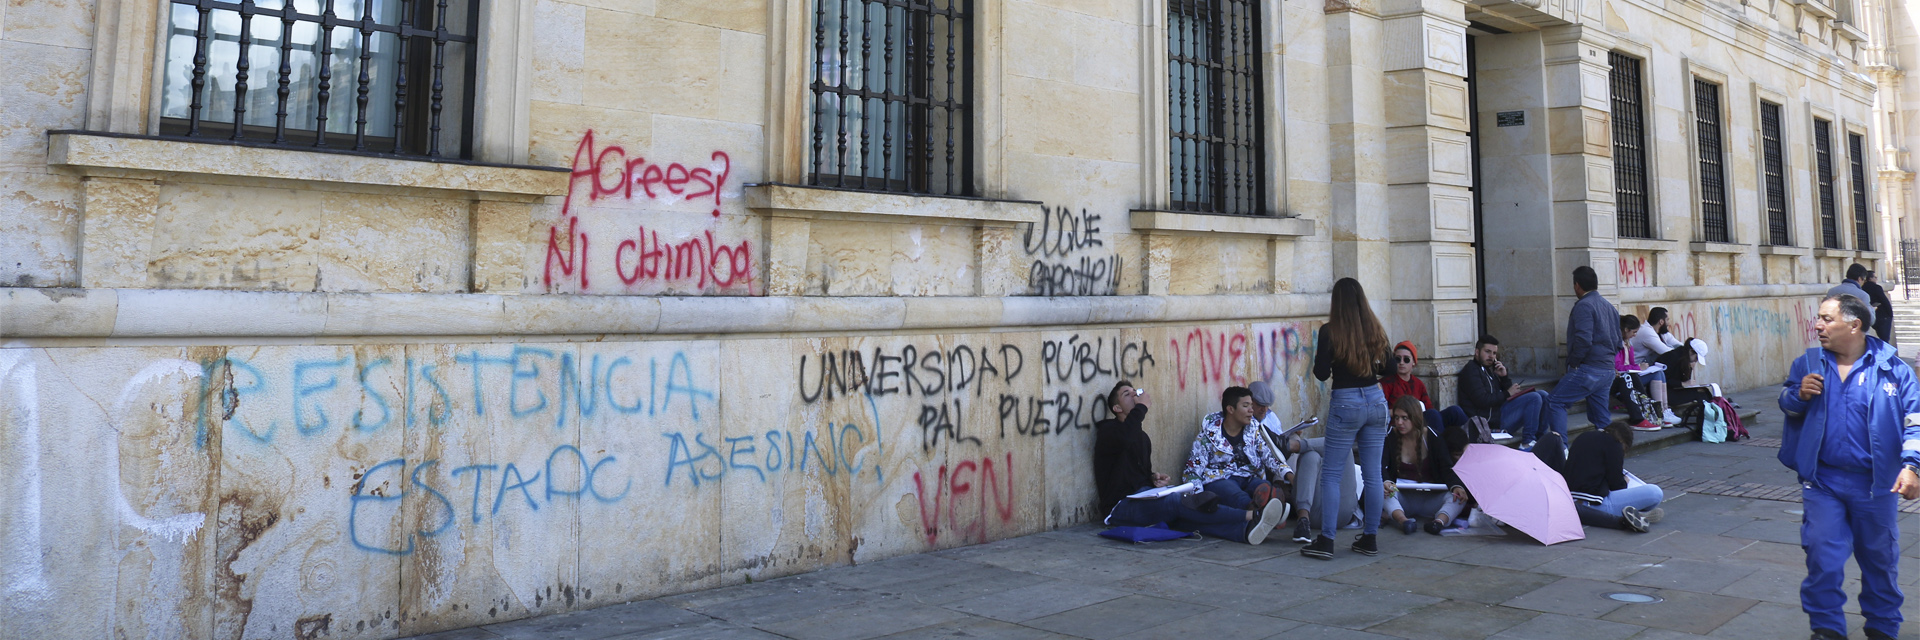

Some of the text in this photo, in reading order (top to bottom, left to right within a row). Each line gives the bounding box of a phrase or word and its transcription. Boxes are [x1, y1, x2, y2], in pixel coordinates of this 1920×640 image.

[543, 215, 588, 290] NI
[1619, 254, 1646, 286] M-19
[799, 334, 1156, 404] UNIVERSIDAD PÚBLICA
[1170, 328, 1246, 391] VIVE
[195, 346, 714, 450] RESISTENCIA
[917, 391, 1109, 452] PAL PUEBLO
[912, 452, 1014, 545] VEN
